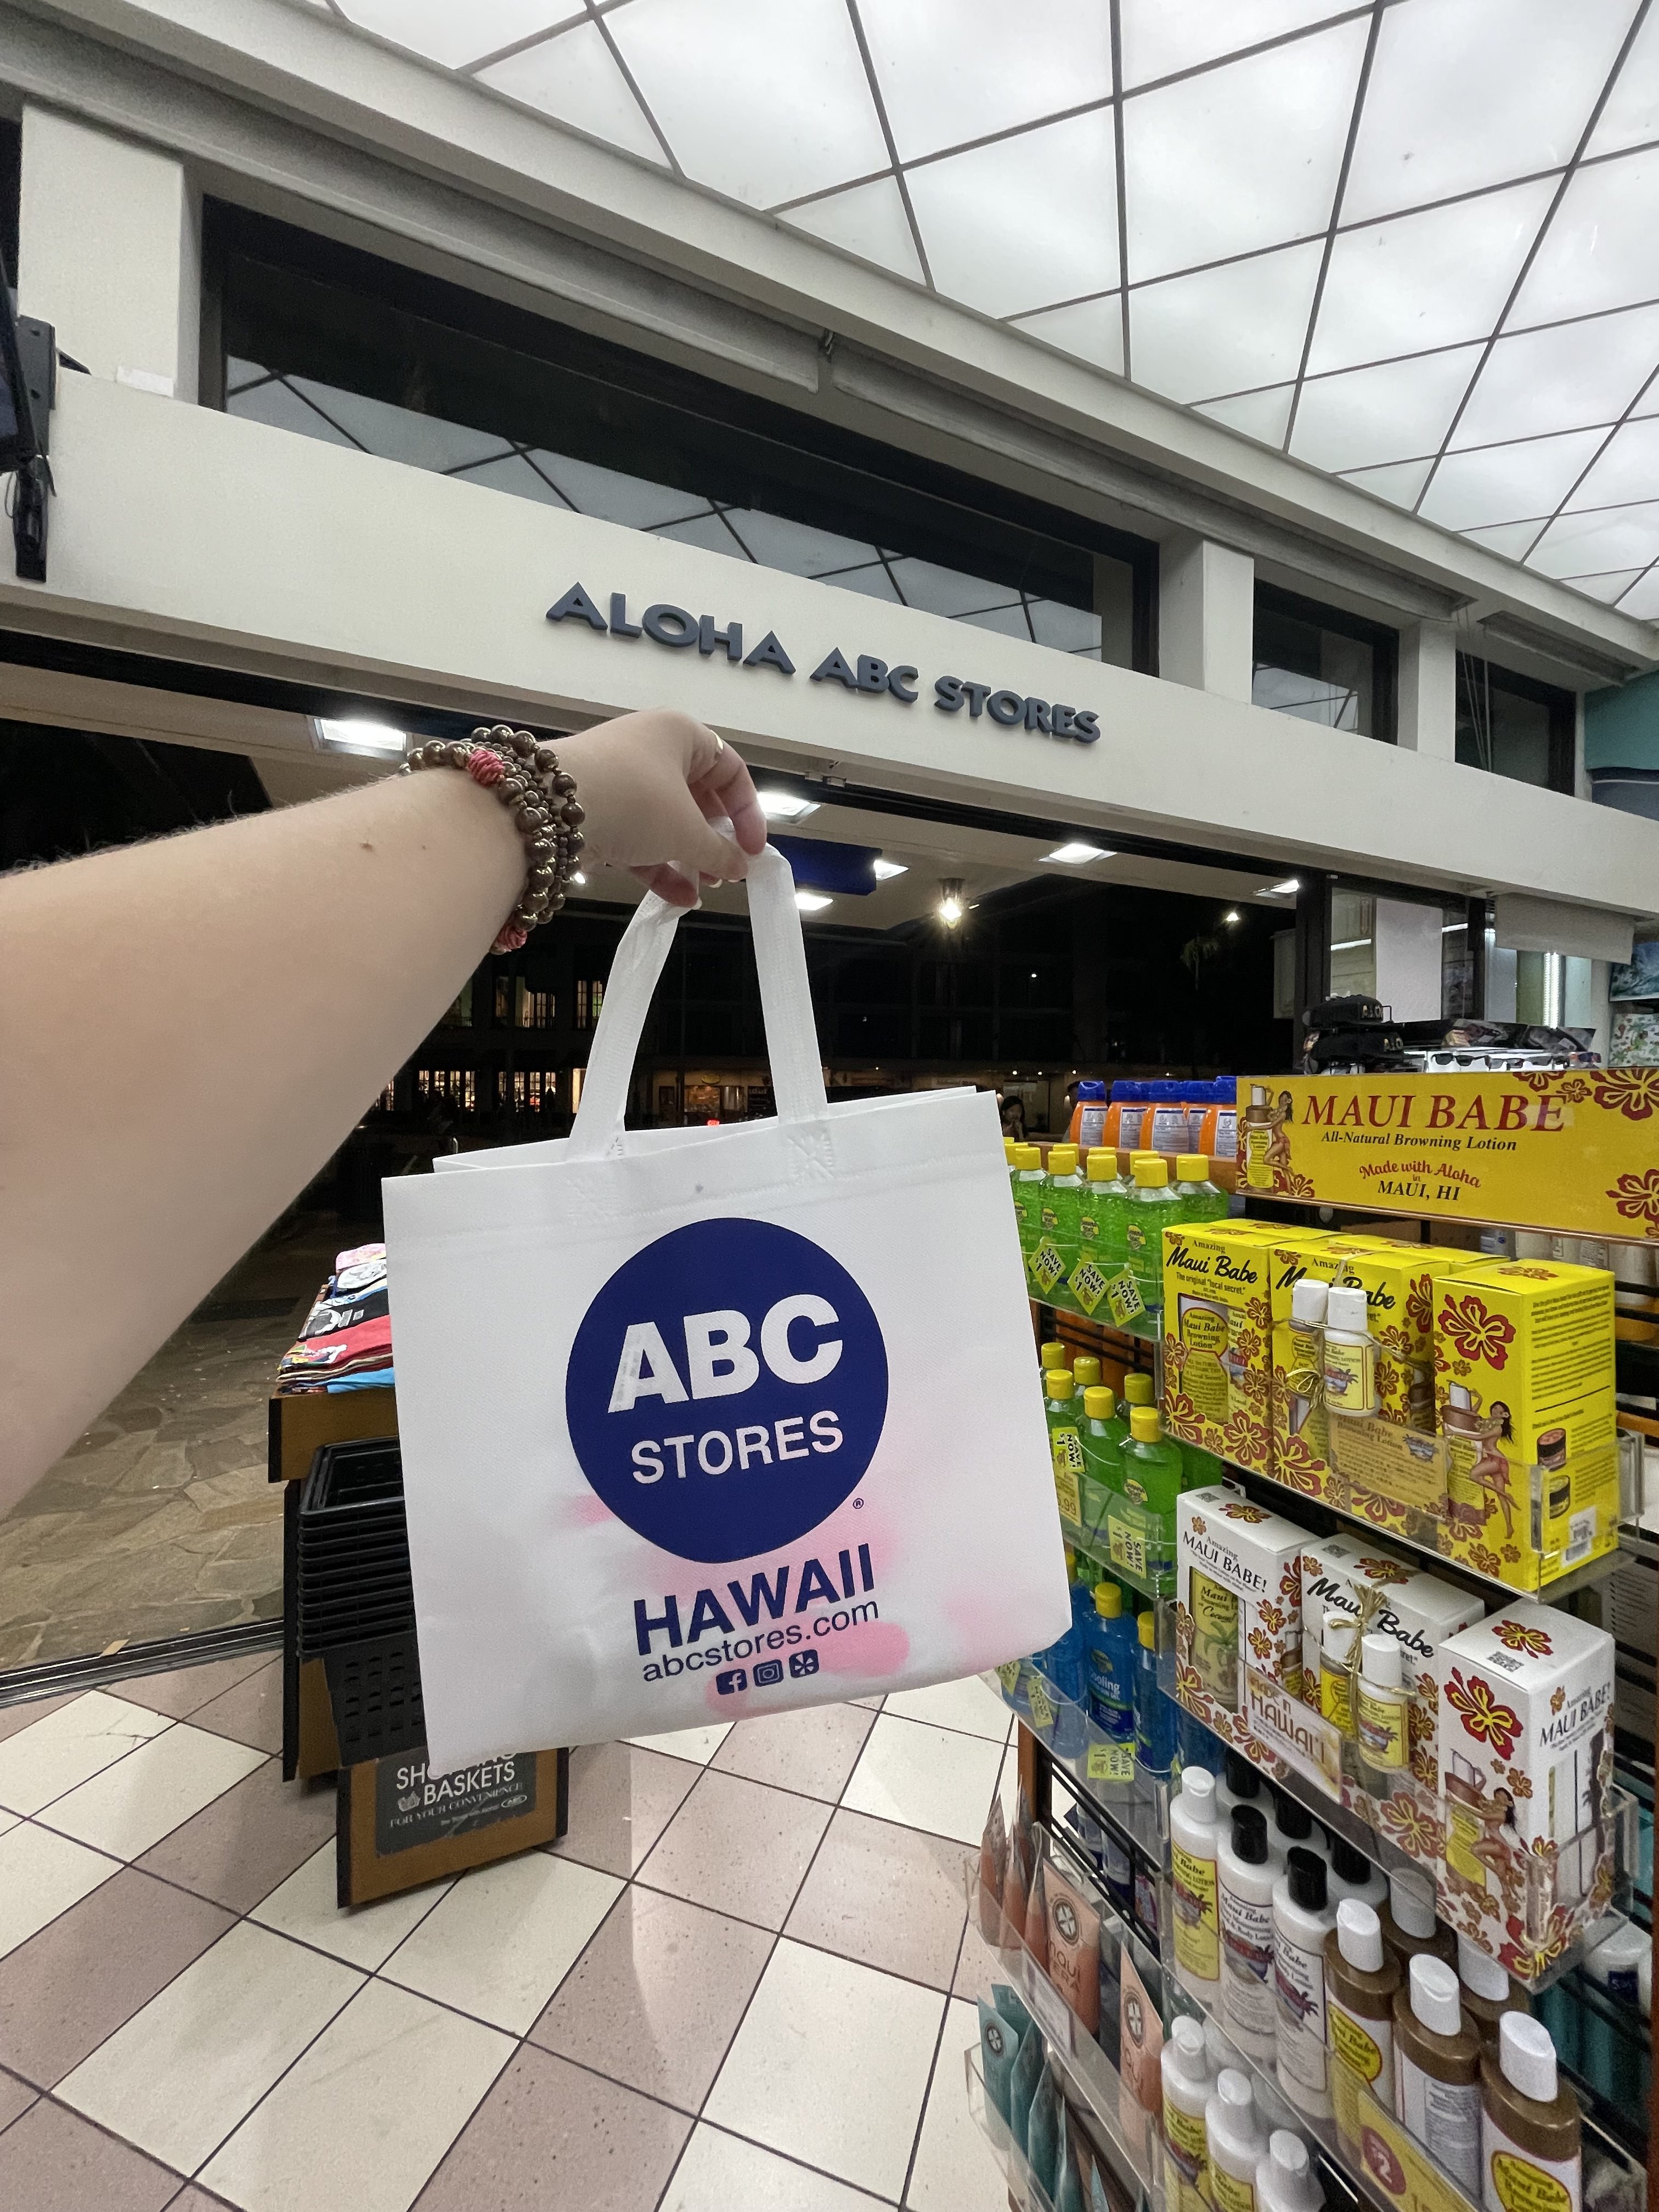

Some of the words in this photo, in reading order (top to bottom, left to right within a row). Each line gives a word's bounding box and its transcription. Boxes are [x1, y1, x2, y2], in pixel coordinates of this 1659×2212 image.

[546, 582, 796, 675] ALOHA
[810, 647, 919, 703] ABC
[934, 675, 1101, 743] STORES
[1302, 1094, 1415, 1127] MAUI
[1425, 1094, 1566, 1132] BABE
[1321, 1131, 1390, 1145] All-Natural
[1393, 1133, 1462, 1151] Browning
[1466, 1136, 1517, 1152] Lotion
[1359, 1160, 1399, 1180] Made
[1401, 1160, 1433, 1174] with
[1434, 1163, 1481, 1188] Aloha
[1412, 1173, 1421, 1182] in
[1378, 1180, 1430, 1201] MAUI,
[1436, 1185, 1462, 1201] HI
[1047, 1248, 1062, 1272] SAVE
[1192, 1239, 1226, 1254] Amazing
[1040, 1251, 1058, 1278] NOW!
[1086, 1264, 1105, 1290] SAVE
[1166, 1246, 1211, 1273] Maui
[1214, 1255, 1259, 1284] Babe
[1311, 1257, 1355, 1276] Amazng
[1079, 1268, 1101, 1297] NOW!
[1176, 1272, 1186, 1280] The
[1186, 1274, 1206, 1285] original
[1118, 1280, 1135, 1314] NOW!
[1126, 1280, 1141, 1311] SAVE
[1183, 1318, 1201, 1331] Maui
[1203, 1322, 1226, 1333] Babe
[1187, 1329, 1221, 1344] Browning
[1229, 1318, 1243, 1329] aui
[607, 1294, 844, 1414] ABC
[1189, 1338, 1213, 1349] Lotion
[1367, 1421, 1393, 1438] Babe
[1376, 1435, 1403, 1451] Lotion
[631, 1410, 843, 1485] STORES
[1123, 1531, 1134, 1568] NOW!
[1133, 1541, 1143, 1572] SAVE
[1183, 1531, 1219, 1564] MAUI
[1222, 1556, 1267, 1593] BABE!
[1206, 1536, 1239, 1562] Amazing
[633, 1543, 875, 1656] HAWAII
[1200, 1585, 1228, 1602] Maui
[1306, 1577, 1362, 1617] Mau
[1377, 1609, 1435, 1658] Babe
[642, 1599, 879, 1682] abcstores.com
[1539, 1708, 1576, 1747] MAUI
[1580, 1681, 1610, 1722] BABE!
[1121, 1753, 1131, 1776] SAVE
[424, 1760, 515, 1806] BASKETS
